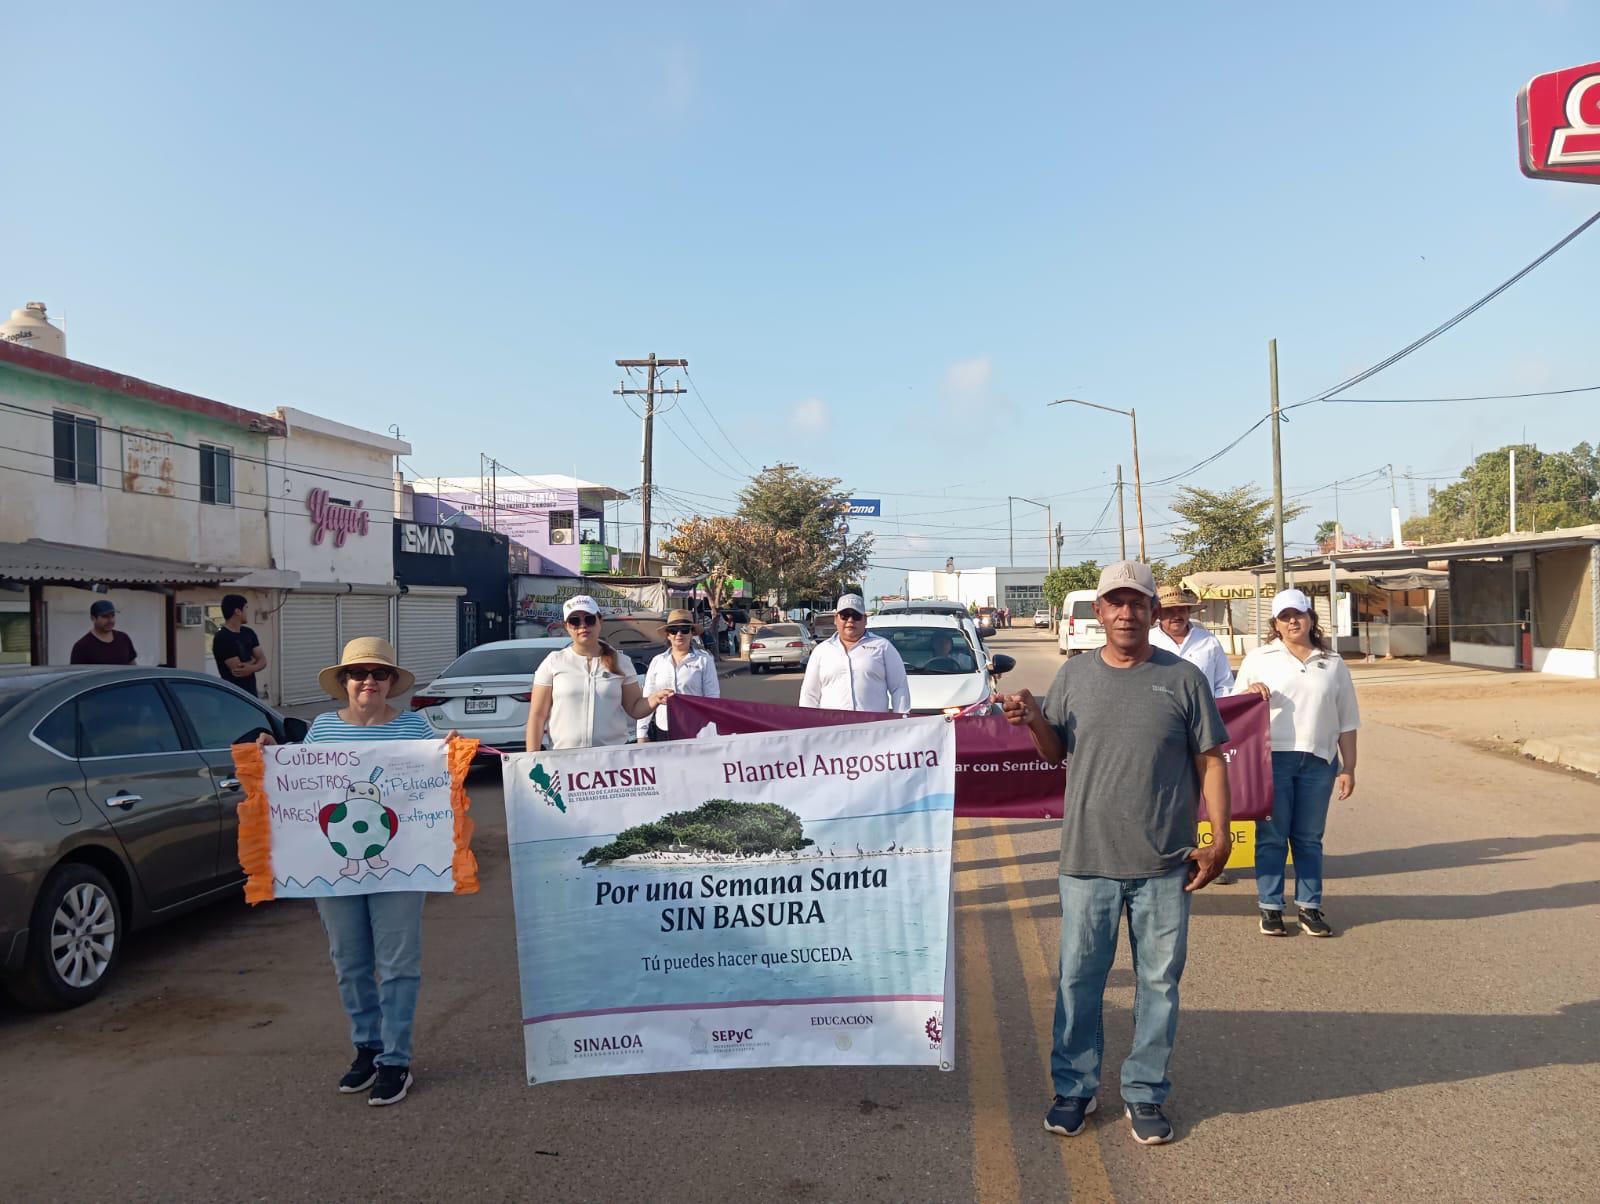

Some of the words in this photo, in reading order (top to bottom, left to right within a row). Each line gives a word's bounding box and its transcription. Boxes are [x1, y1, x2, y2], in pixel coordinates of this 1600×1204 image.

[309, 488, 370, 548] Yaya's
[722, 755, 806, 783] Plantel
[812, 749, 939, 780] Angostura
[955, 764, 970, 772] ar
[973, 763, 999, 772] con
[276, 774, 351, 792] NUESTROS
[567, 767, 657, 791] ICATSIN
[408, 792, 425, 801] SE
[595, 879, 640, 906] Por
[646, 880, 693, 902] una
[701, 874, 802, 898] Semana
[810, 866, 888, 892] Santa
[660, 906, 705, 932] SIN
[713, 900, 826, 929] BASURA
[641, 955, 661, 972] Tú
[664, 951, 715, 974] puedes
[718, 951, 758, 968] hacer
[761, 952, 789, 968] que
[791, 946, 853, 964] SUCEDA
[810, 1013, 873, 1026] EDUCACIÓN
[574, 1034, 643, 1053] SINALOA
[712, 1028, 753, 1043] SEPyC
